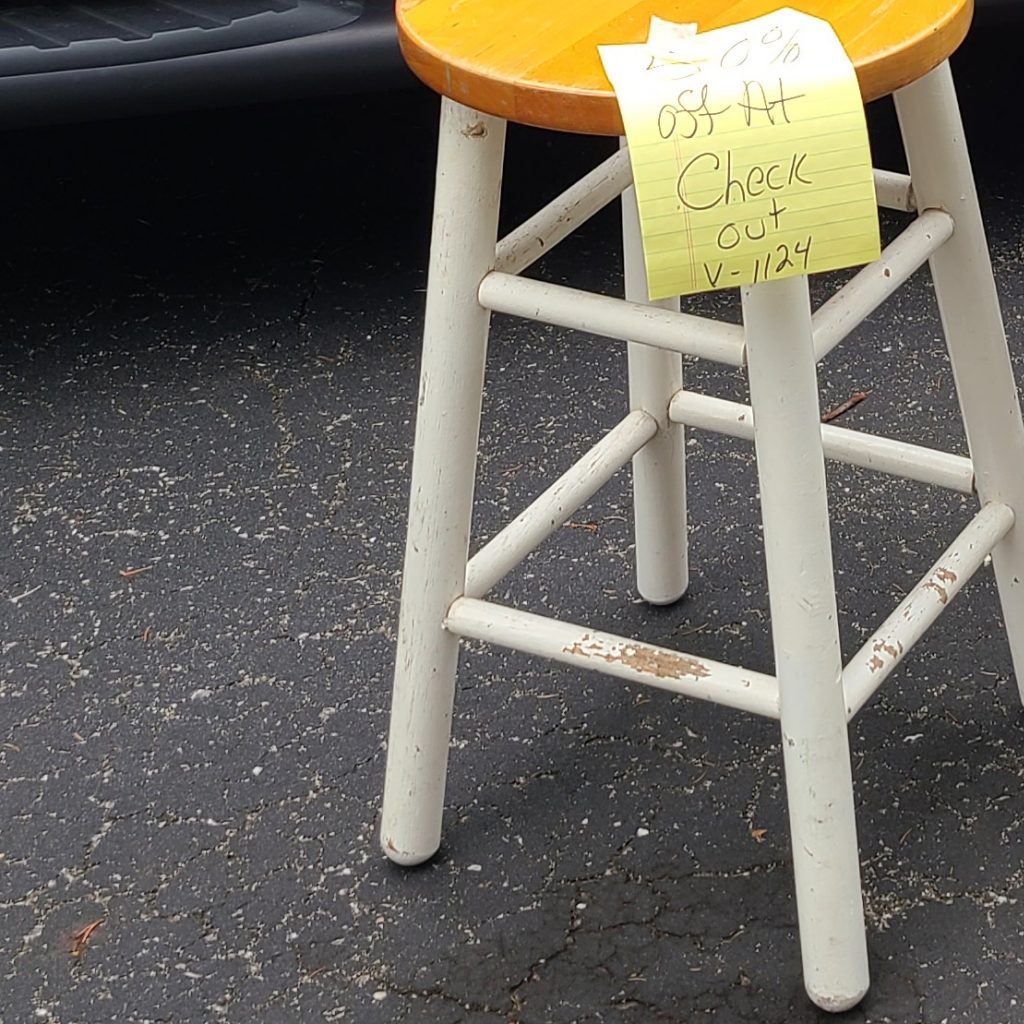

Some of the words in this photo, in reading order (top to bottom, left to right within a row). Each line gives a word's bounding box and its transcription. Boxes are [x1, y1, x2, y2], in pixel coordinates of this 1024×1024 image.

[737, 77, 806, 126] At
[676, 149, 813, 210] Check
[717, 198, 787, 250] out
